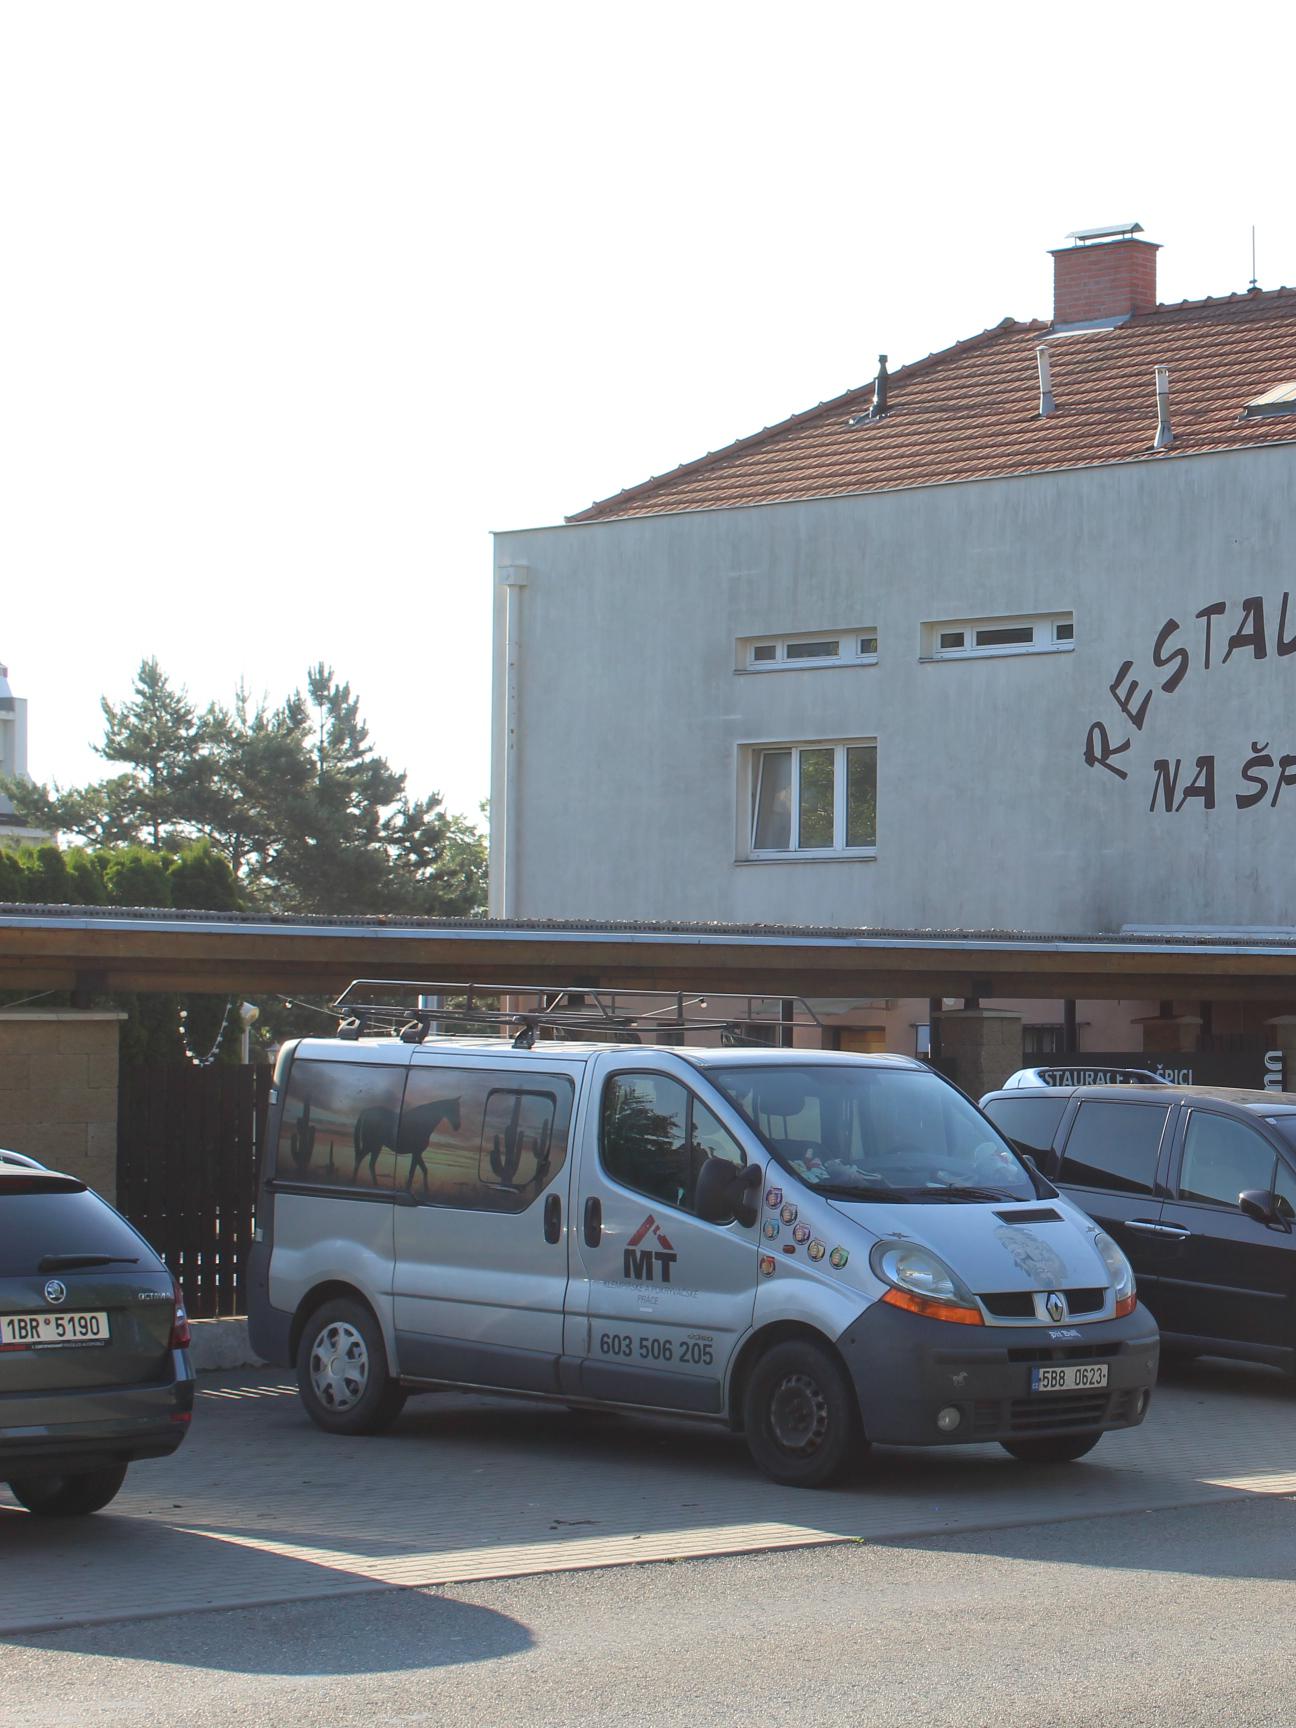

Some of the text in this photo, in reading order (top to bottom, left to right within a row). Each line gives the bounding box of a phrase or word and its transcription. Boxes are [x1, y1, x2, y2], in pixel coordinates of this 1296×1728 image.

[1149, 755, 1216, 813] NA
[624, 1248, 677, 1283] MT
[7, 1315, 101, 1340] 1BR 5190
[600, 1333, 714, 1365] 603 506 205
[1042, 1367, 1103, 1388] 5B8 0623
